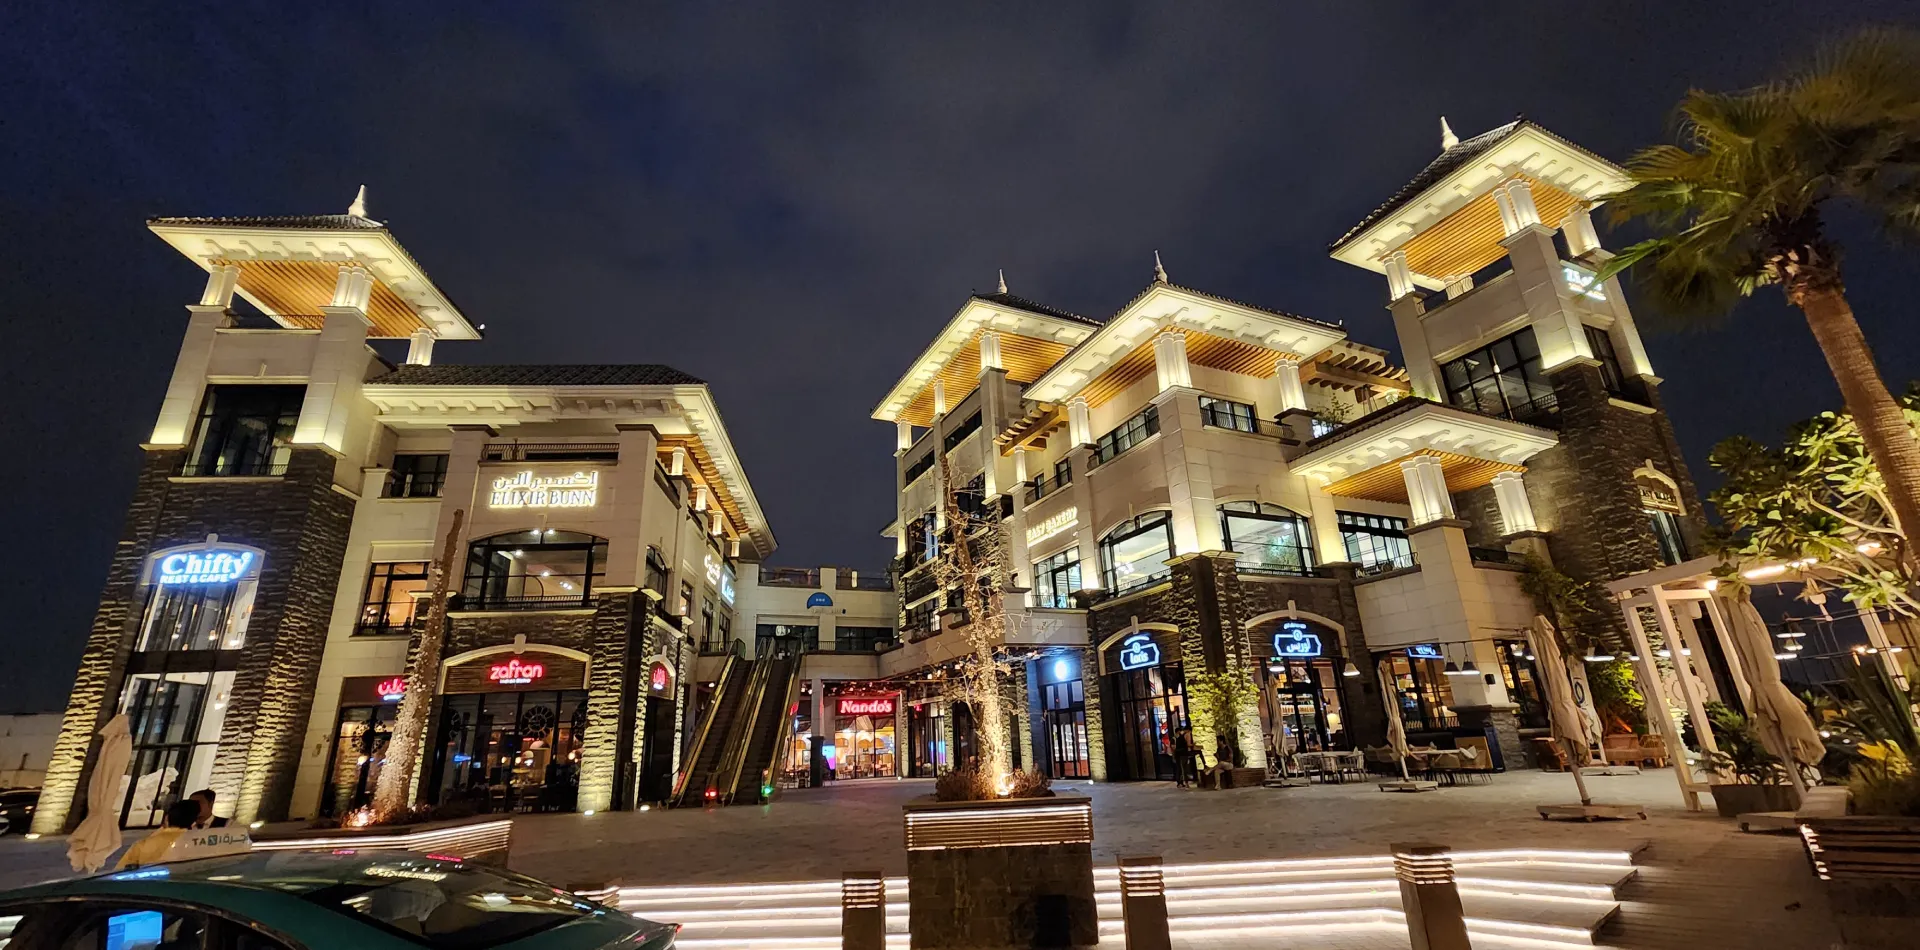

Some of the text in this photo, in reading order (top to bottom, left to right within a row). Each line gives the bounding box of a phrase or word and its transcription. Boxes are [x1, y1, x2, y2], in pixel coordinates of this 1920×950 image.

[489, 489, 596, 507] ELIXIR BUNN
[161, 551, 254, 579] Chifty
[490, 659, 543, 680] zafran
[840, 700, 892, 714] Nando's
